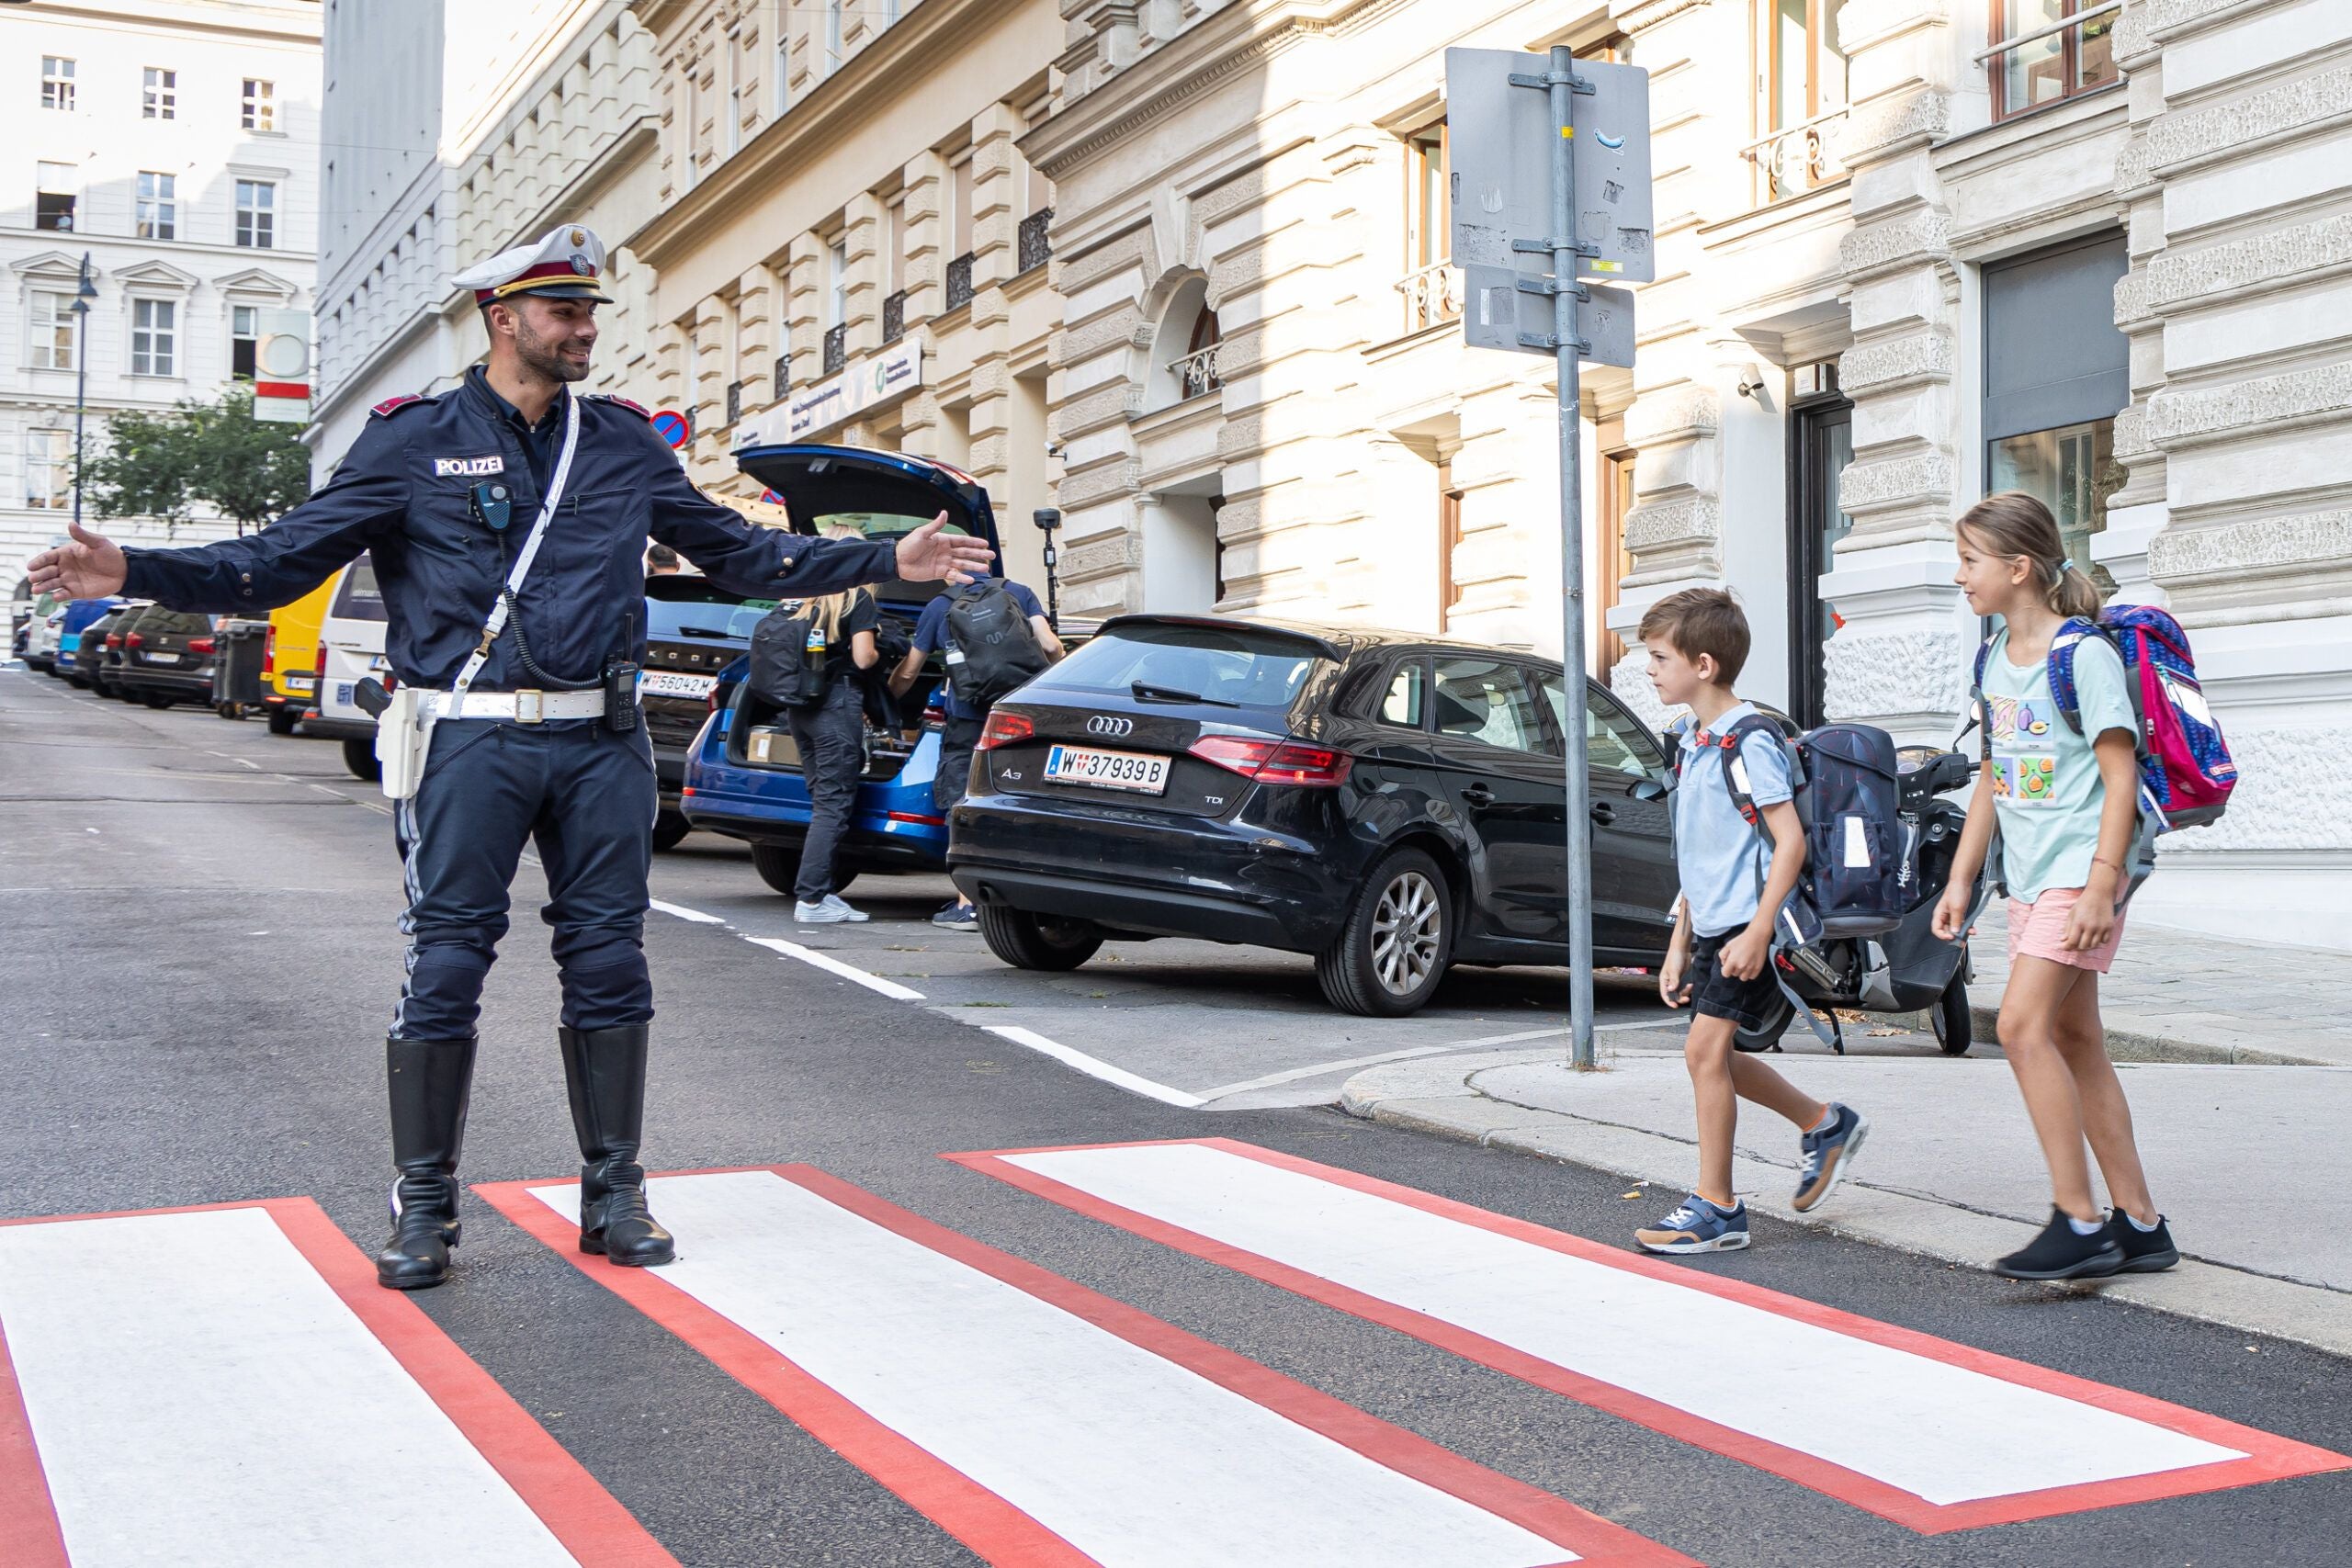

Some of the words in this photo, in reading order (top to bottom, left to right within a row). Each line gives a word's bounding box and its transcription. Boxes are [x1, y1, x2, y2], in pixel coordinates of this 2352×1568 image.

[436, 457, 504, 475] POLIZEI
[649, 650, 721, 662] KODA
[643, 674, 651, 686] W
[660, 676, 700, 692] 56042
[1001, 768, 1022, 780] A3
[1062, 751, 1077, 773] W
[1088, 755, 1146, 781] 37939
[1148, 761, 1161, 783] B
[1204, 795, 1224, 805] TDI
